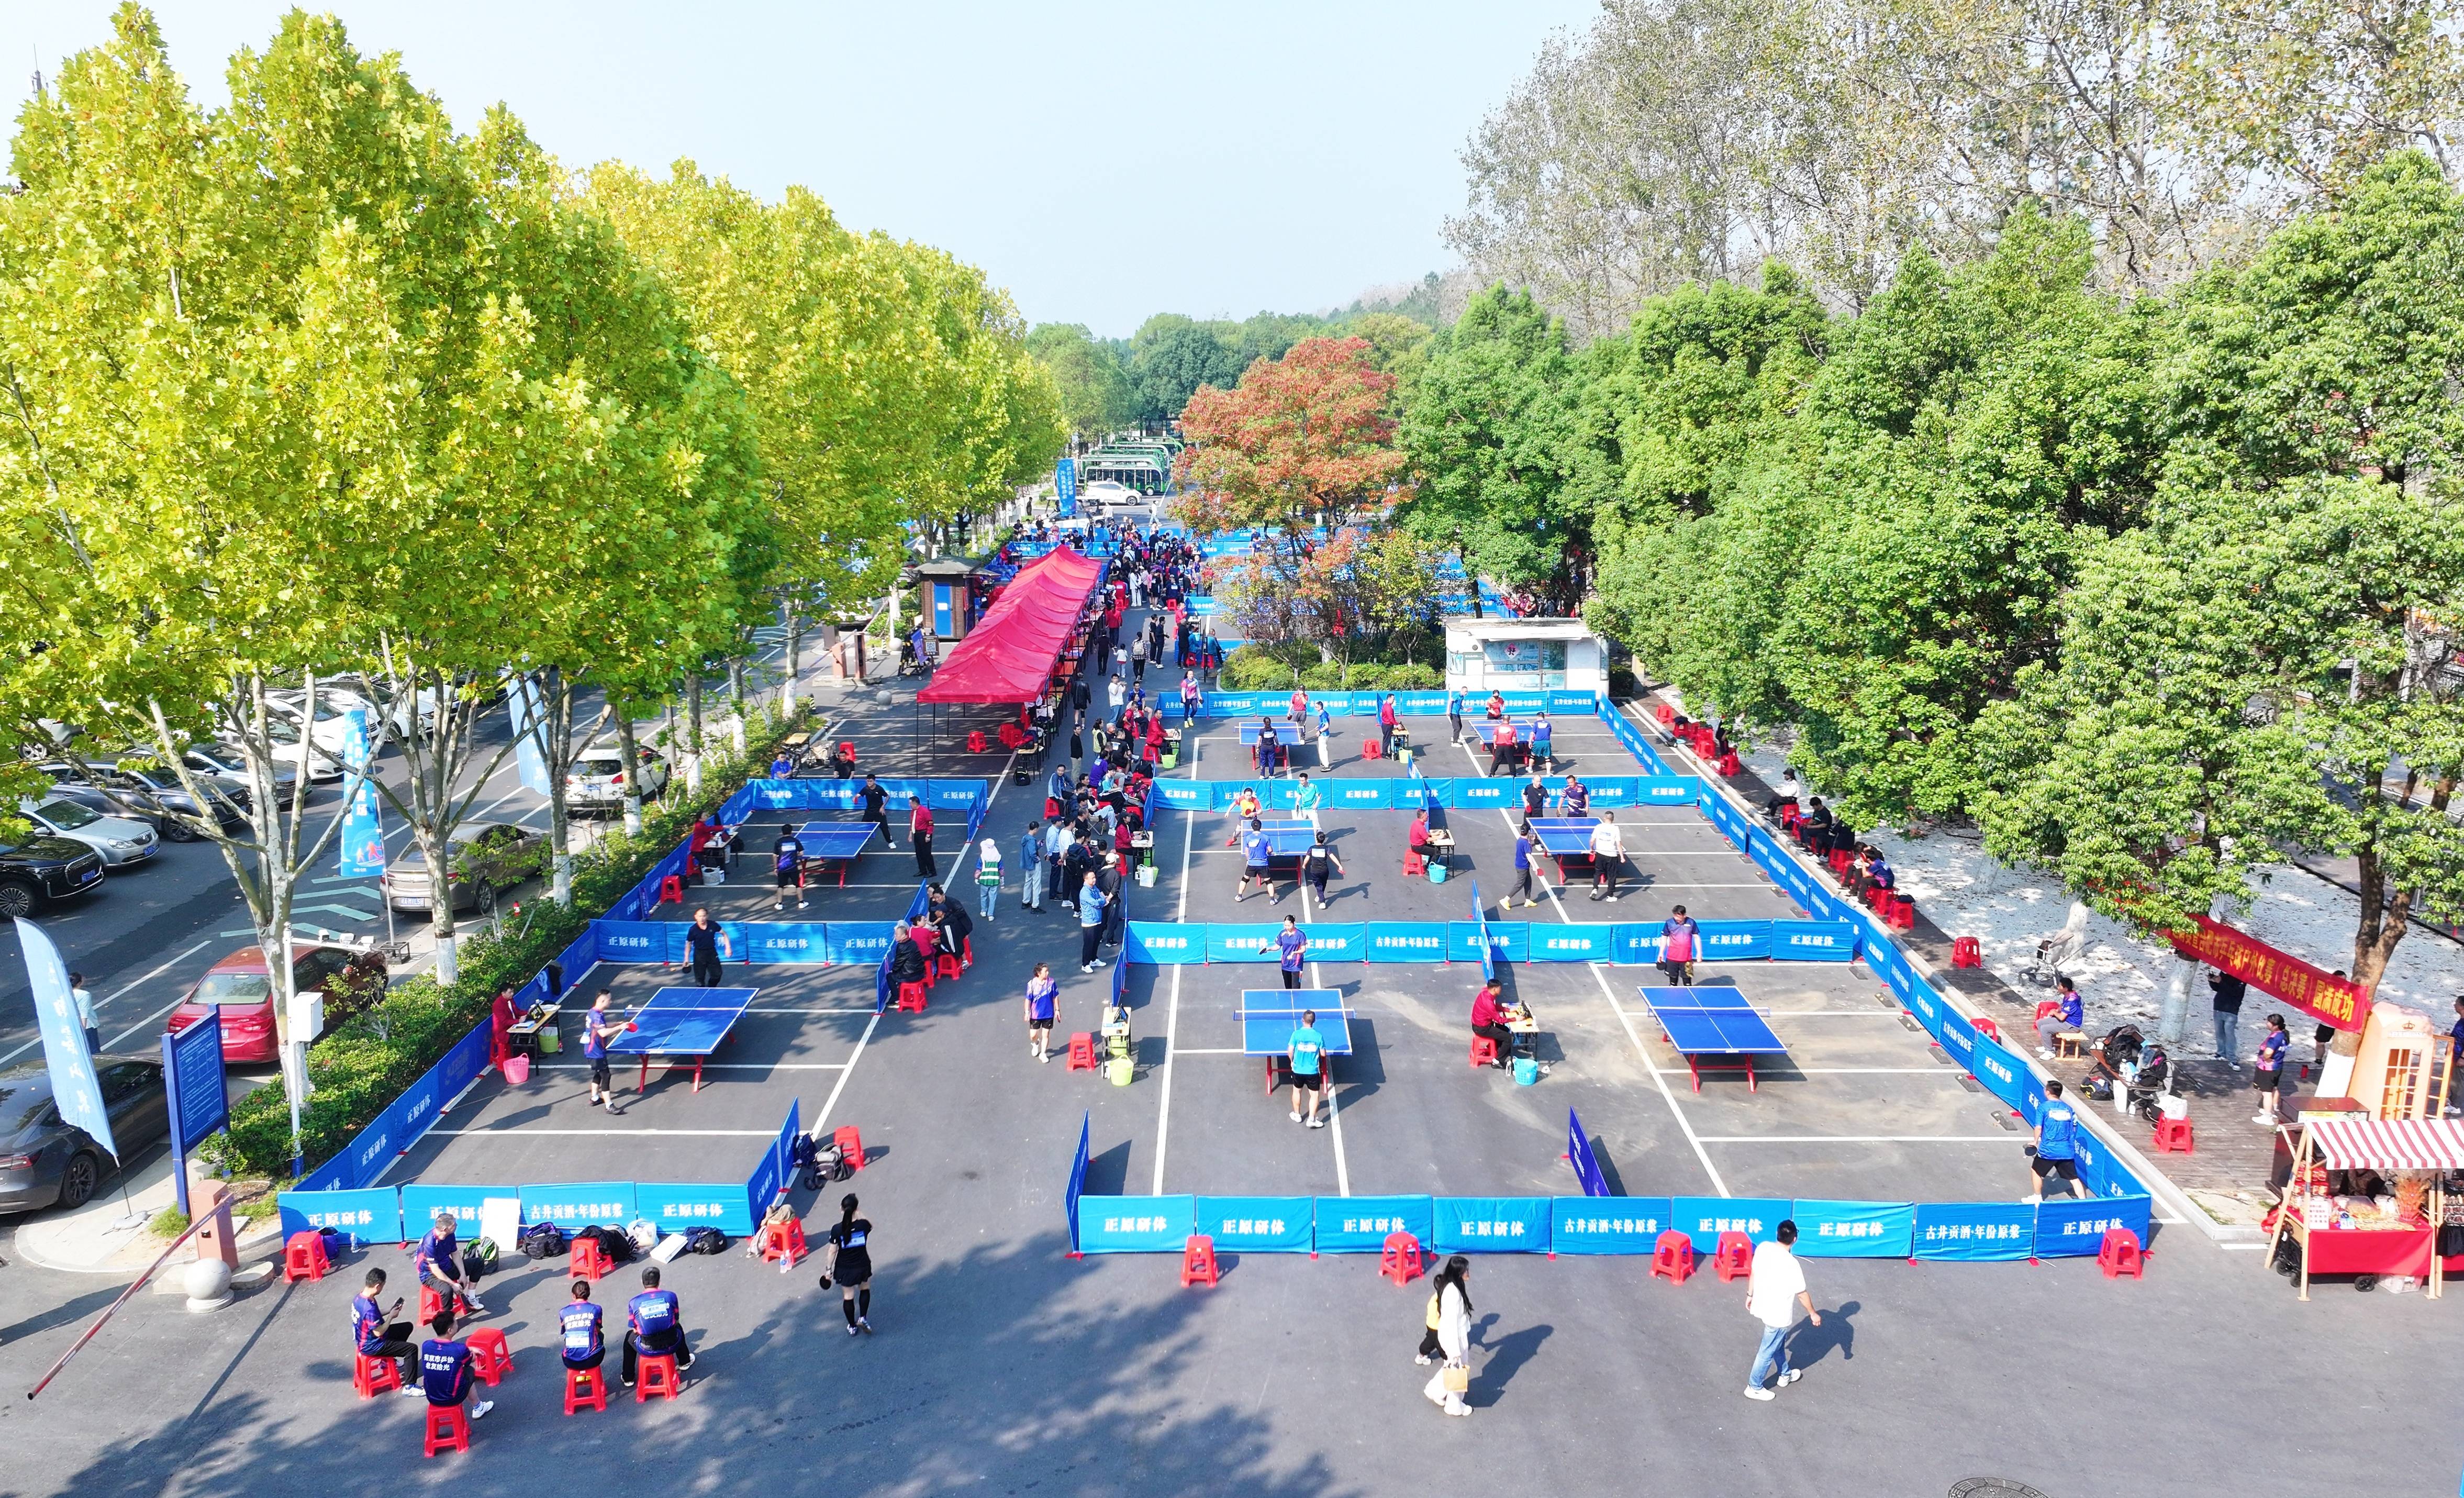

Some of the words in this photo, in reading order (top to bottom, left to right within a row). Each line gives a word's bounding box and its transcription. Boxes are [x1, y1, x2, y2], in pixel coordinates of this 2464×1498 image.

[609, 937, 649, 947] 正原研体
[1145, 938, 1187, 948] 正原研体
[1548, 939, 1591, 949] 正原研体
[1711, 935, 1753, 945] 正原研体
[1791, 935, 1834, 946] 正原研体
[664, 1204, 723, 1217] 正原研体
[308, 1210, 373, 1227] 正原研体
[1105, 1217, 1166, 1231] 正原研体
[1344, 1217, 1405, 1233] 正原研体
[1699, 1218, 1763, 1233] 正原研体
[1223, 1219, 1285, 1235] 正原研体
[1462, 1221, 1524, 1236] 正原研体
[1819, 1222, 1883, 1236] 正原研体
